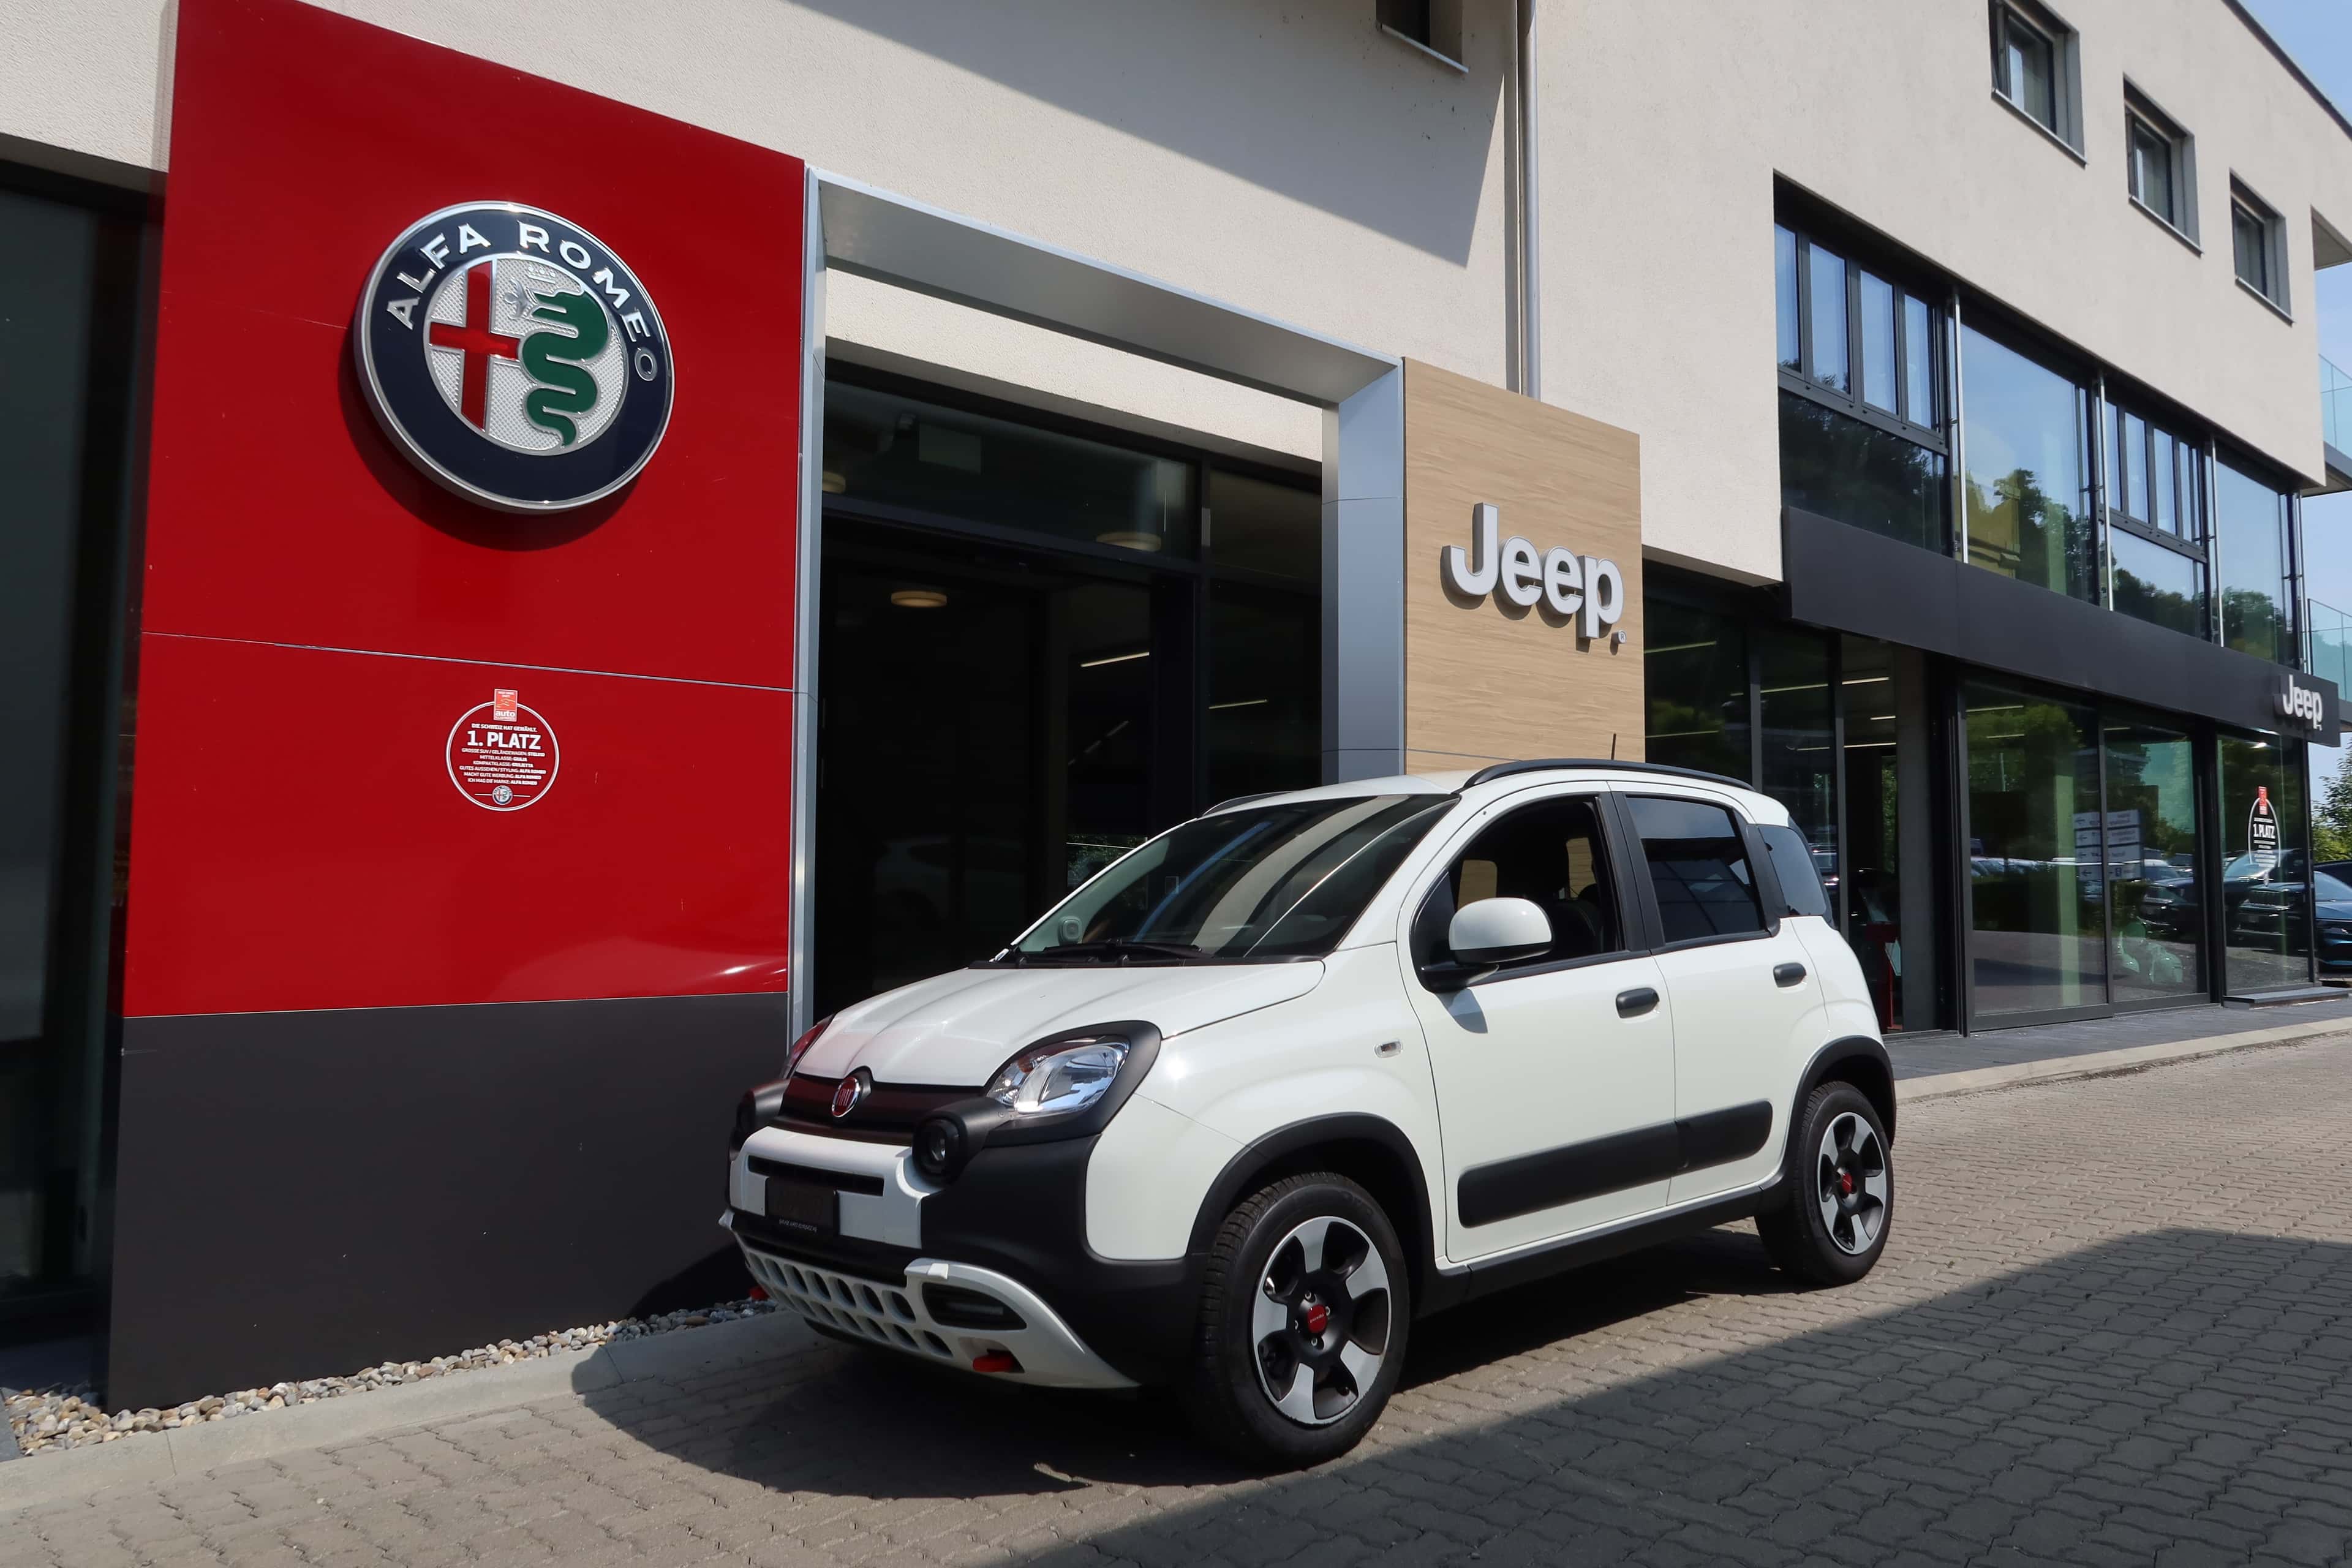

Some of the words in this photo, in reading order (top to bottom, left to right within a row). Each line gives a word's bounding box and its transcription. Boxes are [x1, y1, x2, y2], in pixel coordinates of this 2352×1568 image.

[386, 223, 491, 330] ALFA
[518, 221, 657, 382] ROMEO
[1441, 502, 1624, 639] Jeep
[2282, 674, 2323, 729] Jeep
[467, 730, 483, 747] 1.
[487, 731, 541, 750] PLATZ
[2259, 824, 2275, 839] PLATZ
